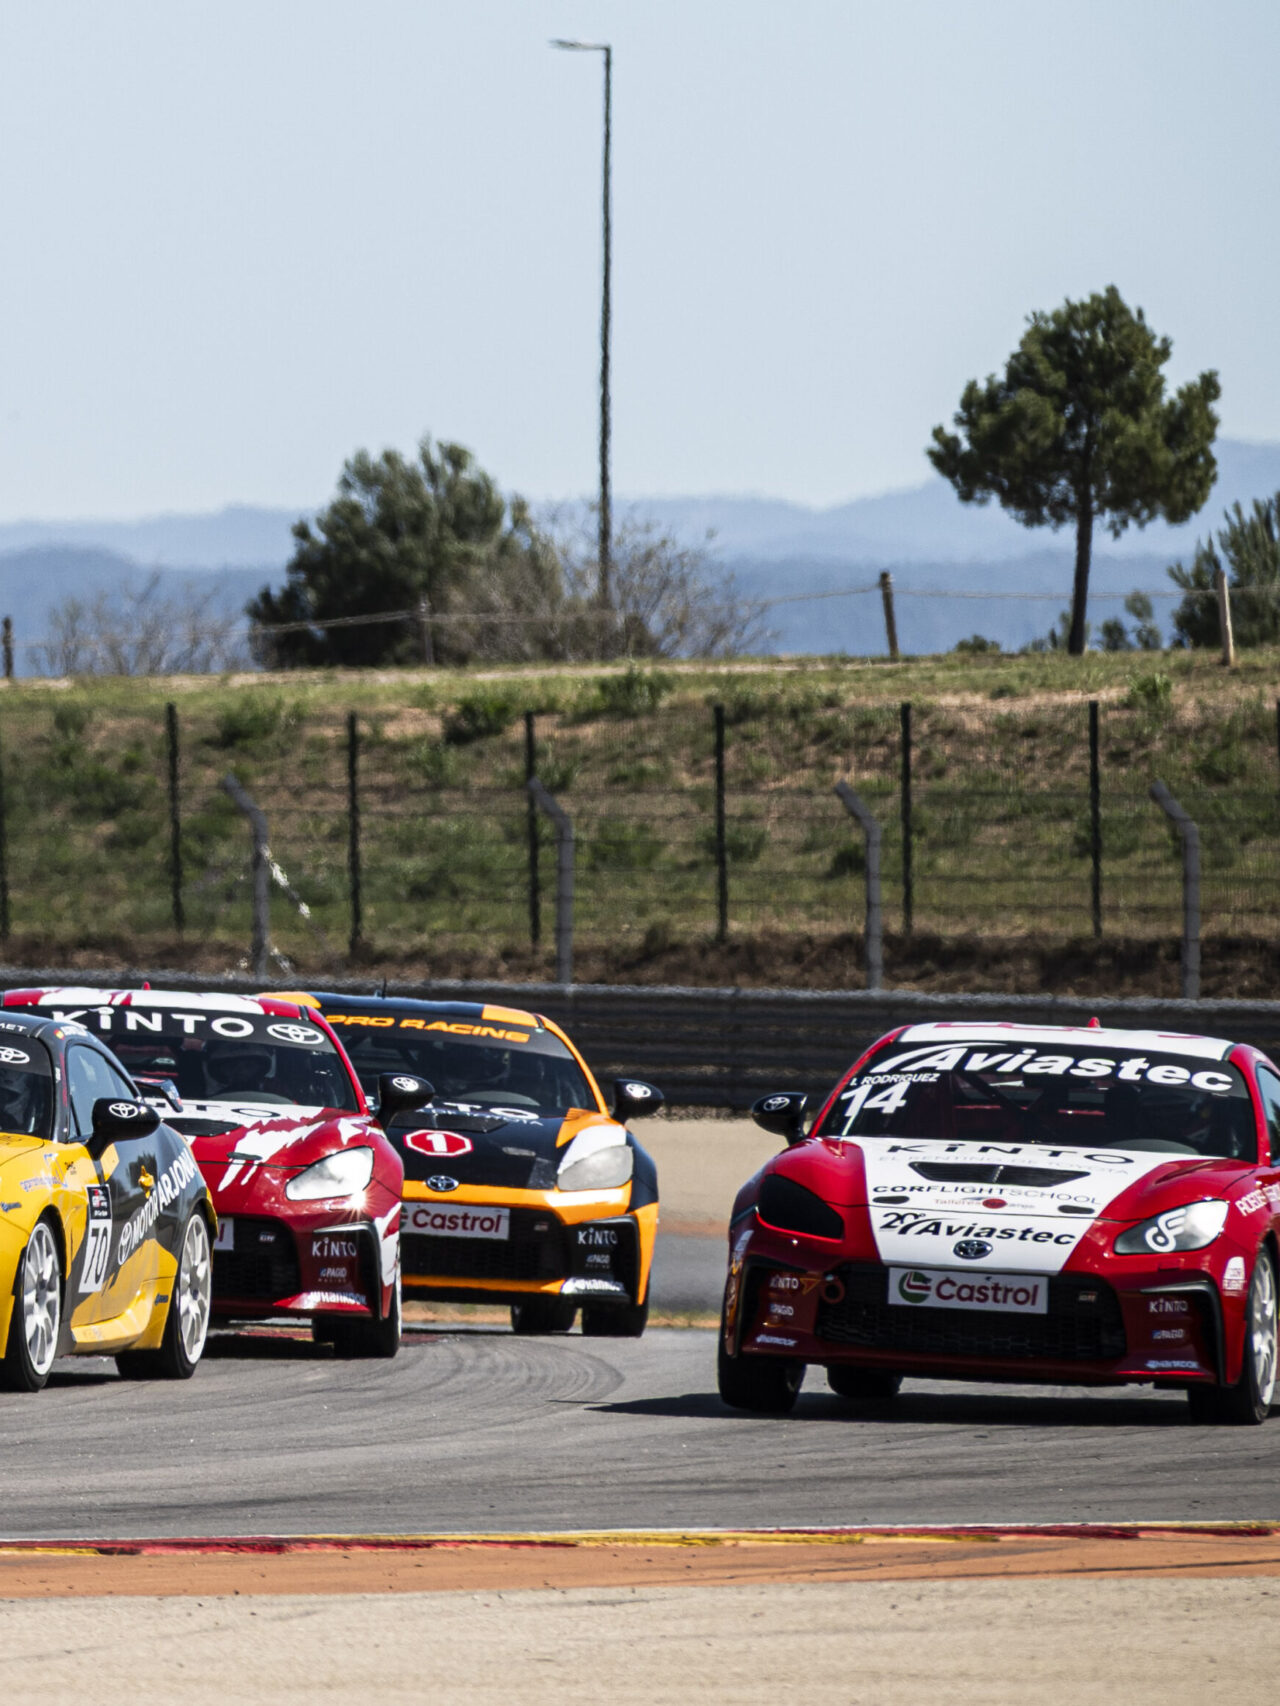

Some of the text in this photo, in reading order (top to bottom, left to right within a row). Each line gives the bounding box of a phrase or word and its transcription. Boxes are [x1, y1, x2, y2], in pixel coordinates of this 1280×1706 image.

[400, 1018, 531, 1043] RACING
[860, 1073, 941, 1085] RODRIGUEZ
[901, 1046, 1233, 1091] Aviastec
[840, 1081, 911, 1117] 14
[425, 1132, 448, 1153] 1
[131, 1147, 198, 1250] MOTOR ARJONA
[411, 1208, 503, 1233] Castrol
[914, 1220, 1076, 1245] Aviastec
[83, 1225, 109, 1285] 70
[935, 1276, 1040, 1306] Castrol
